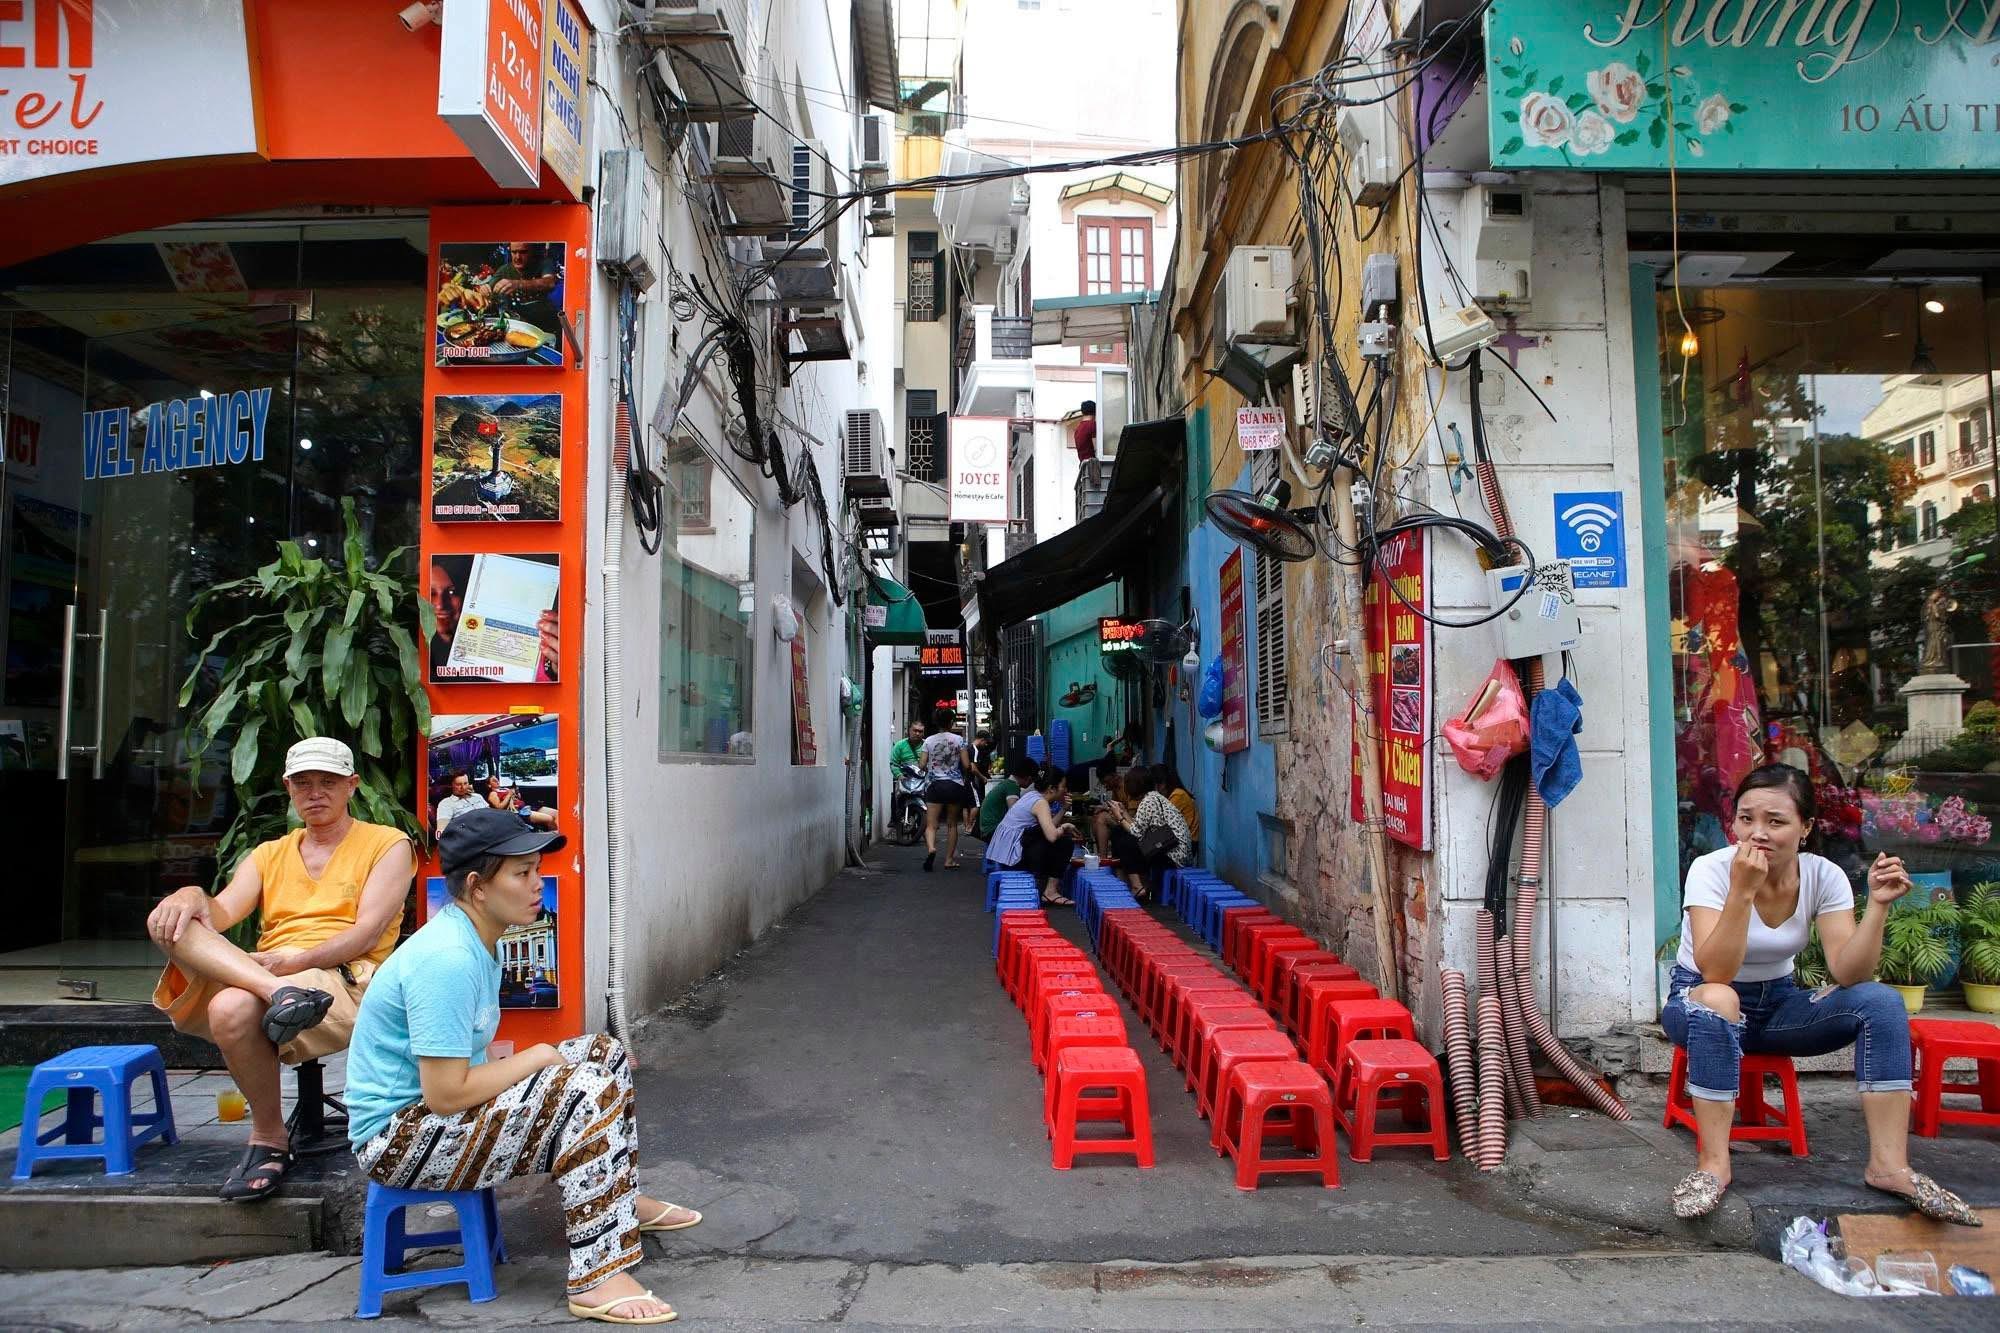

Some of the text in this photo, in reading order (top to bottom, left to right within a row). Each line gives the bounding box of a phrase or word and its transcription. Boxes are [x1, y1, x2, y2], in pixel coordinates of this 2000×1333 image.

[506, 0, 538, 49] INKS
[500, 31, 532, 101] 12-14
[0, 73, 104, 129] el
[1842, 105, 1881, 132] 10
[27, 140, 98, 155] CHOICE
[443, 347, 490, 357] FOOD TOUR
[82, 387, 273, 480] VEL AGENCY
[959, 472, 1000, 485] JOYCE
[954, 491, 984, 502] Homestay
[1395, 609, 1415, 641] RÁN
[921, 647, 939, 664] JOYCE
[941, 647, 962, 664] HOSTEL
[437, 665, 504, 677] VISA EXTENTION
